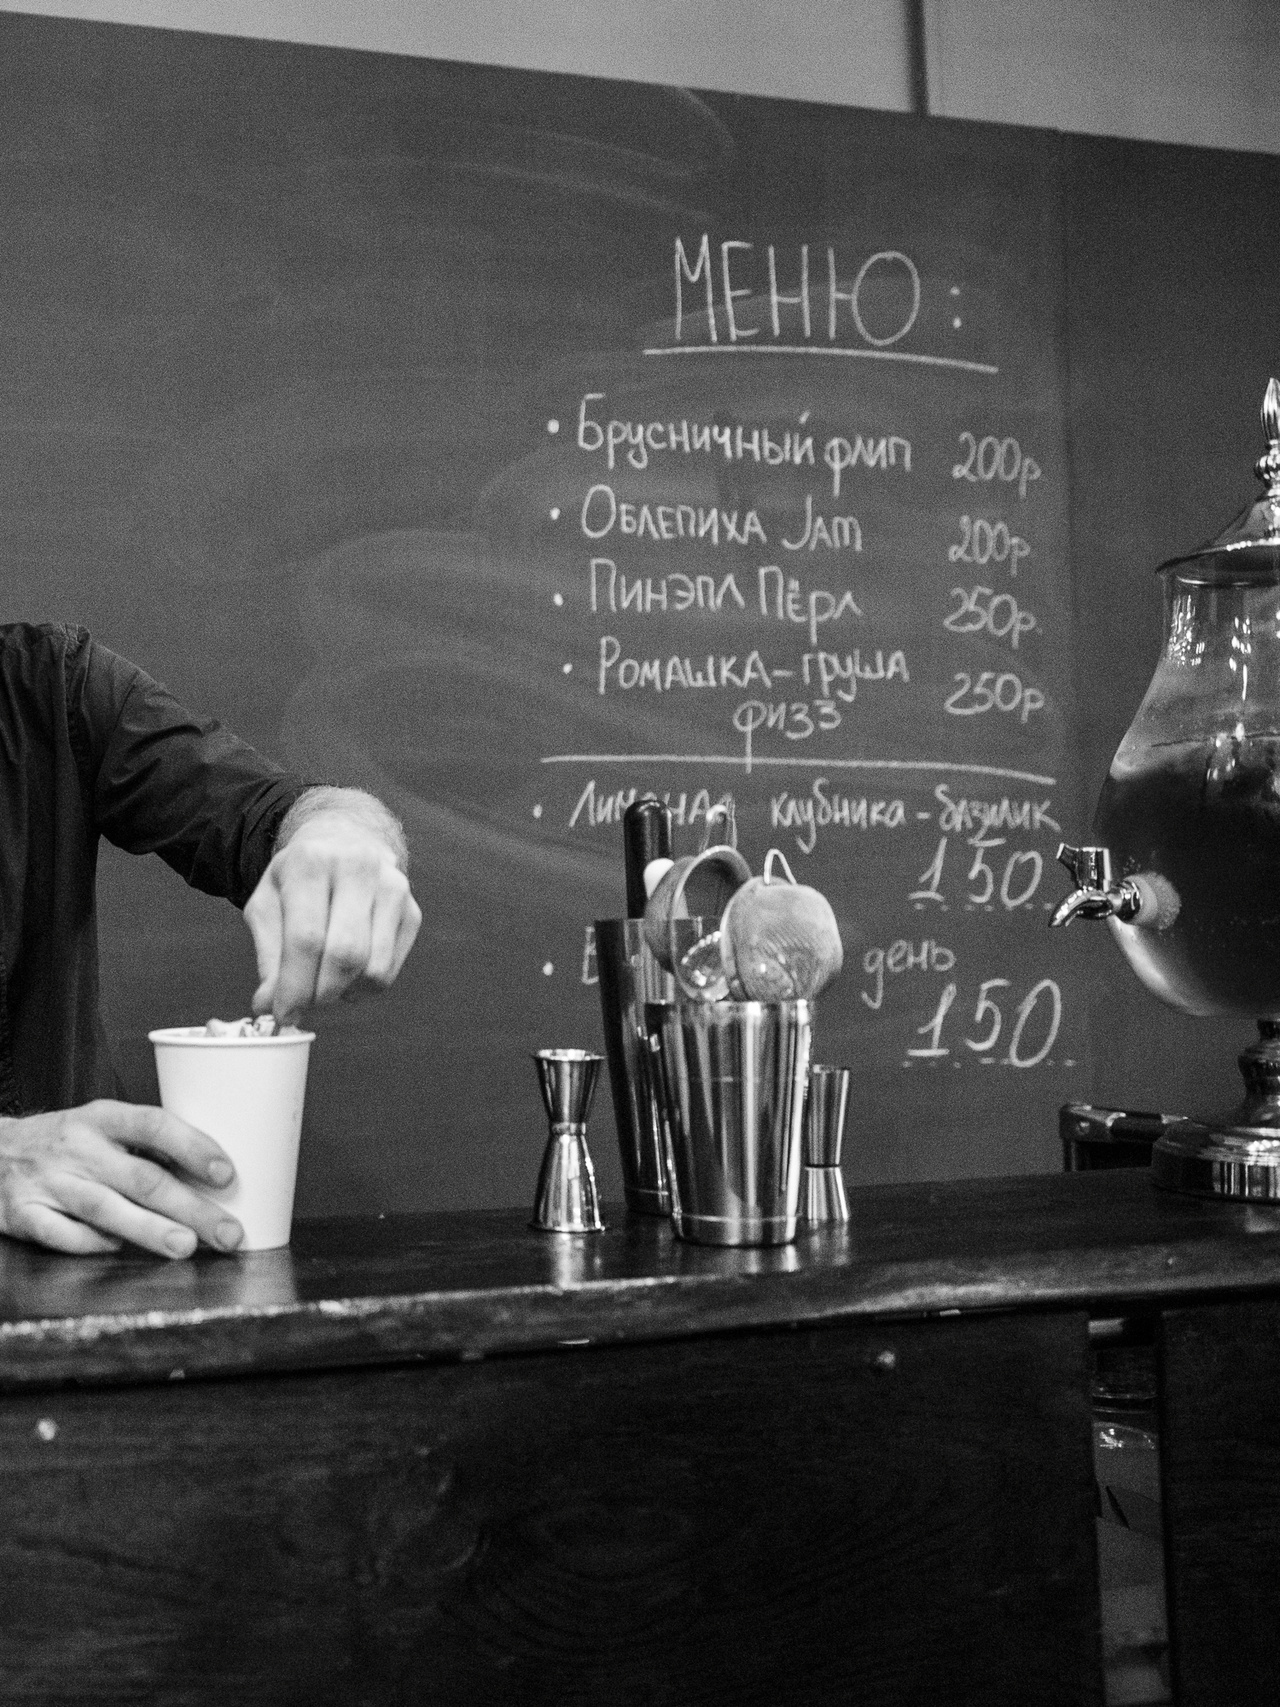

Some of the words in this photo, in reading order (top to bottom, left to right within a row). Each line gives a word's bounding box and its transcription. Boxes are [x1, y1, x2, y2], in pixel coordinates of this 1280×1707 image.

[577, 392, 815, 470] Брусничный
[823, 434, 913, 498] флип
[908, 836, 1043, 908] 150
[861, 938, 957, 1010] день
[907, 978, 1063, 1069] 150
